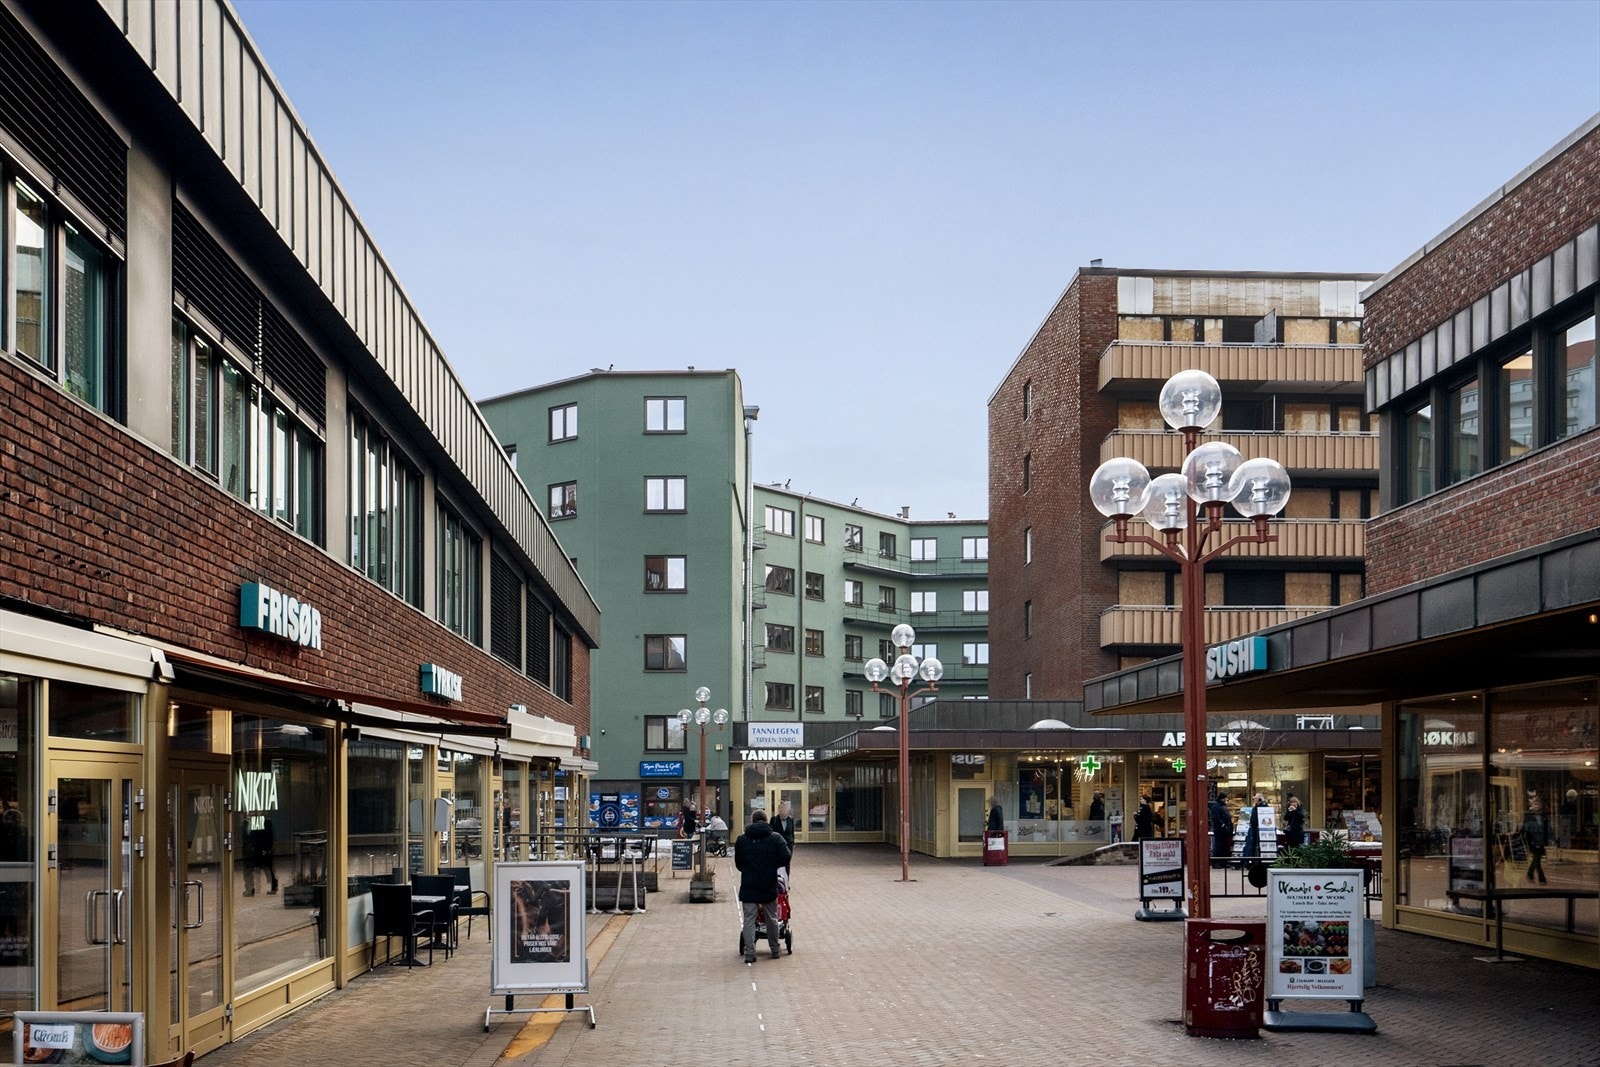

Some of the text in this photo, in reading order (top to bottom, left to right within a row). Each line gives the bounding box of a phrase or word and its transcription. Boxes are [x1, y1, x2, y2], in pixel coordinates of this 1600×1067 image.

[258, 582, 322, 650] FRISØR
[1206, 636, 1255, 681] SUSHI
[432, 663, 463, 702] TYRKISK
[752, 727, 800, 735] TANNLEGENE
[1162, 732, 1242, 747] APTEK
[740, 749, 815, 761] TANNLEGE
[238, 768, 279, 815] NIKITA
[194, 796, 215, 815] NIKITA
[250, 815, 265, 831] HAIR
[1278, 881, 1354, 894] Wasabi Sushi
